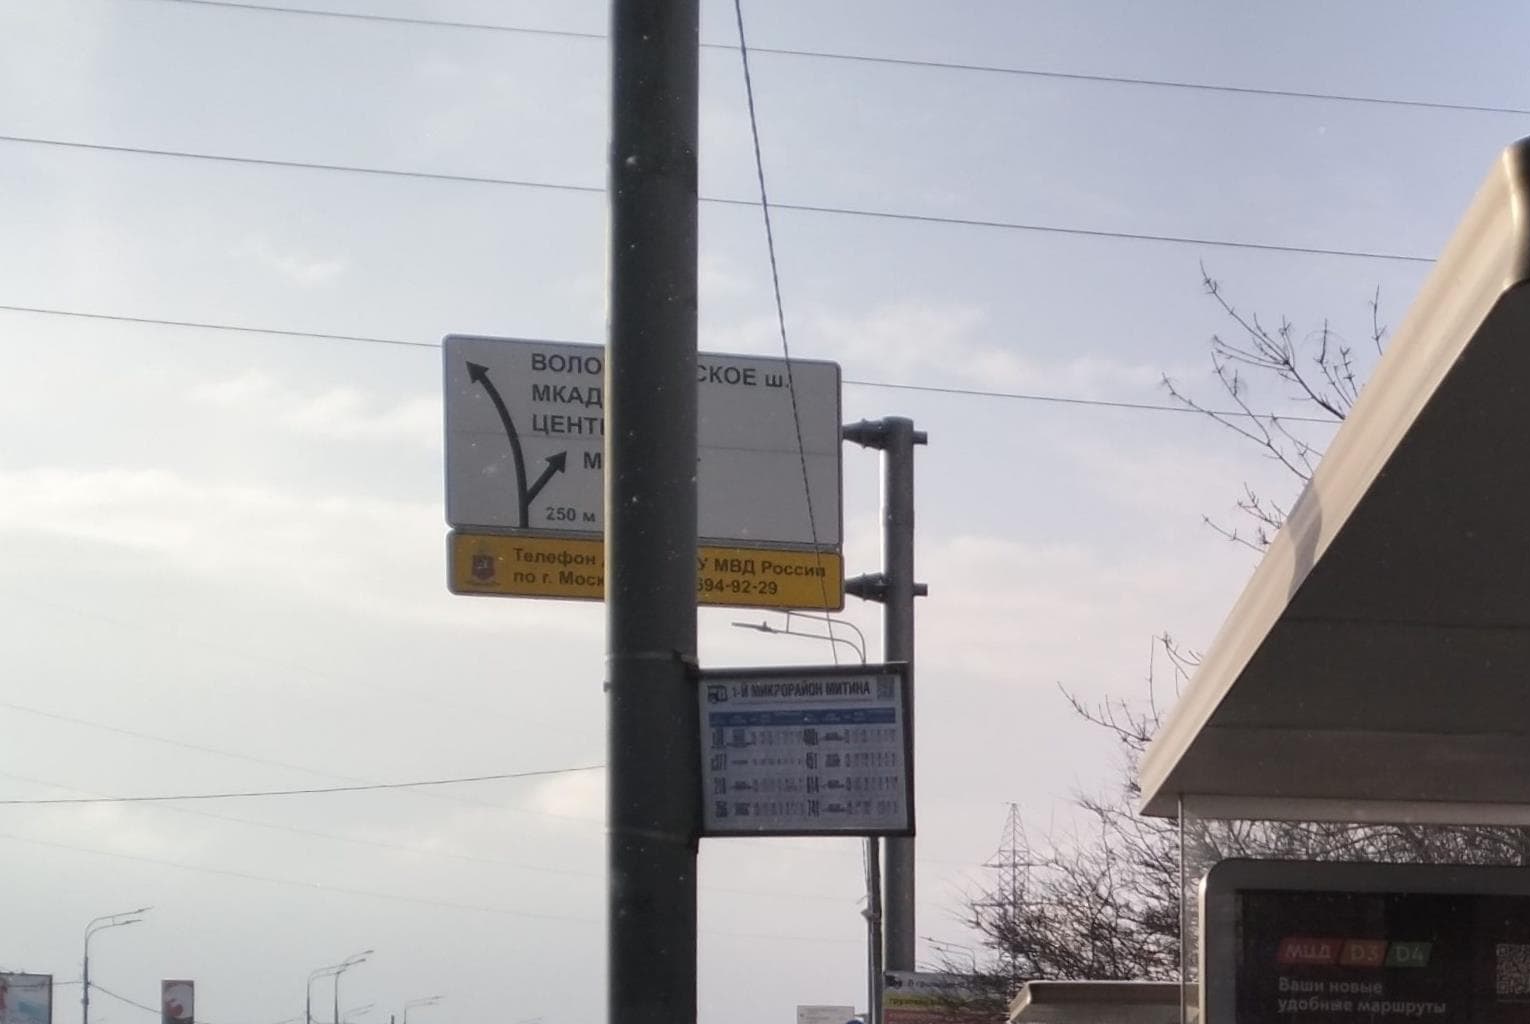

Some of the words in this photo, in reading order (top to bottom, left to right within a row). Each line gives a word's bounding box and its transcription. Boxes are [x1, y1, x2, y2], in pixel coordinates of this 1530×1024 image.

[532, 384, 603, 408] МКАД
[532, 414, 604, 436] ЦЕНТ
[545, 506, 577, 522] 250
[513, 548, 596, 567] Телефон
[714, 557, 756, 576] МВД
[761, 561, 826, 577] России
[513, 571, 536, 583] по
[1395, 945, 1425, 962] D4
[1278, 976, 1324, 993] Ваши
[1329, 981, 1383, 995] новые
[1277, 996, 1353, 1014] удобные
[1357, 1001, 1447, 1017] маршруты
